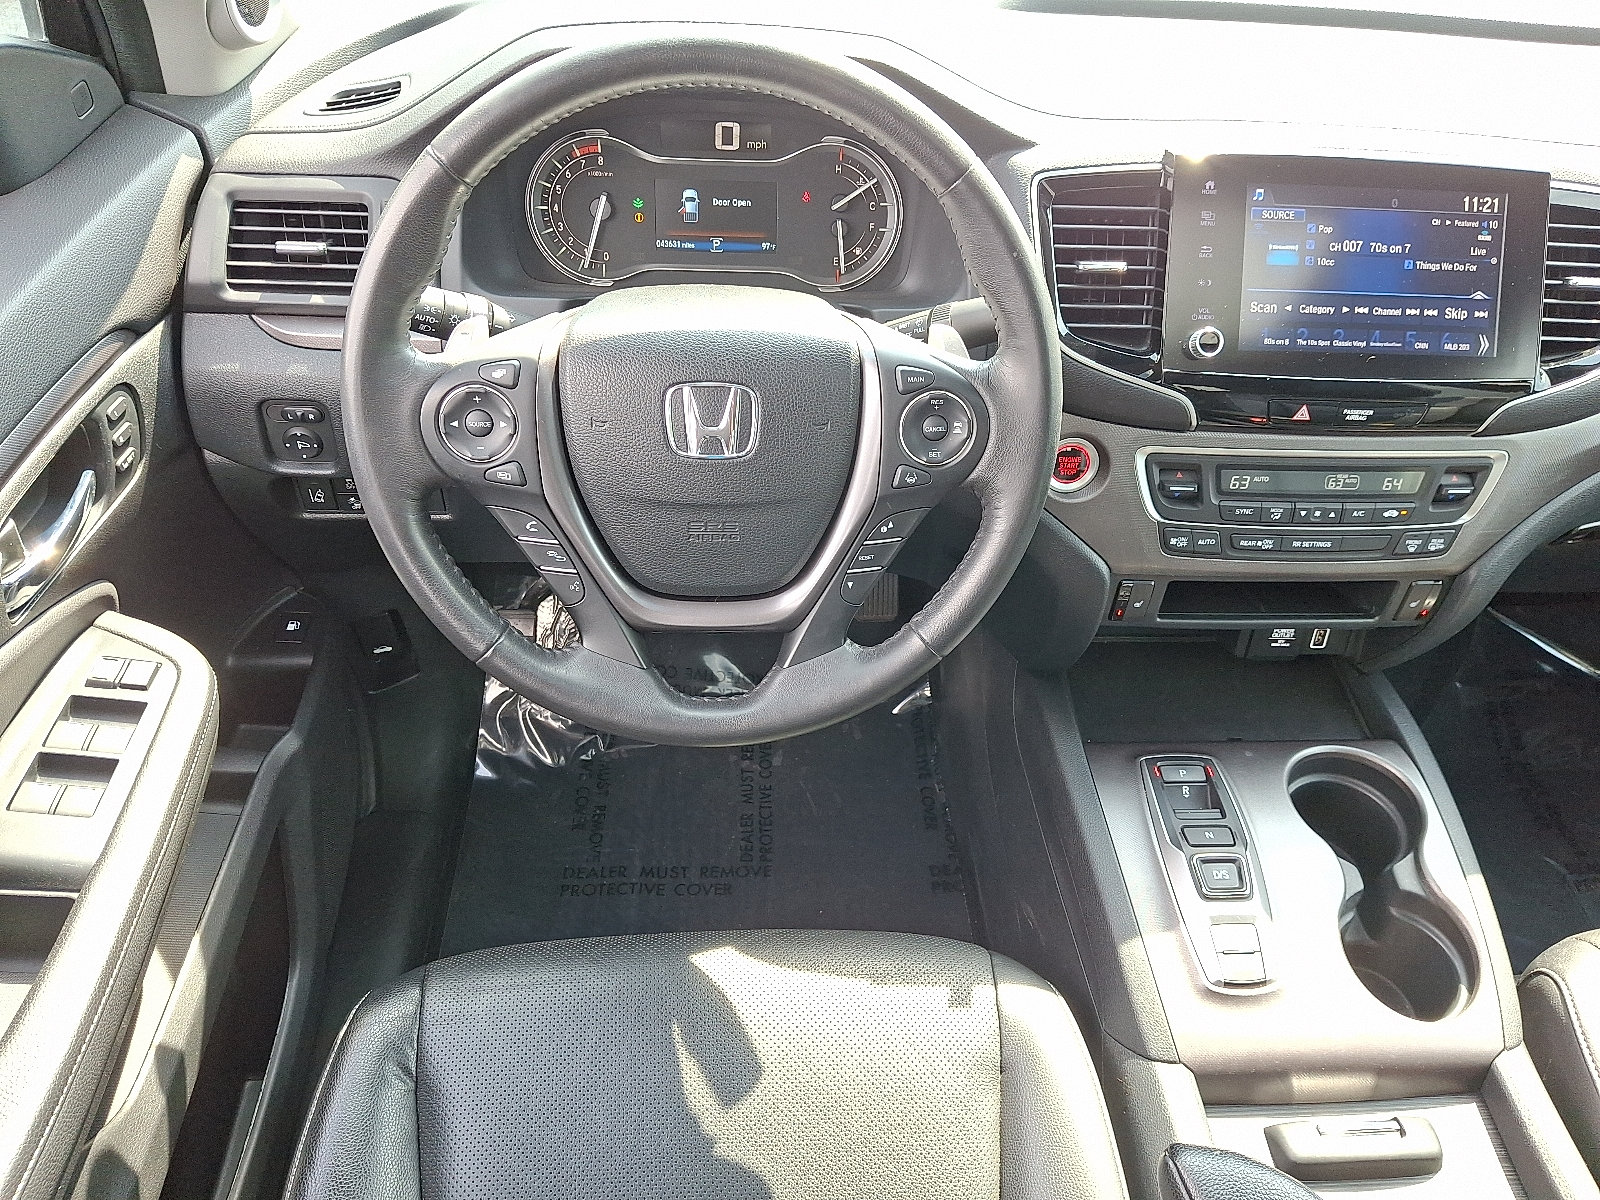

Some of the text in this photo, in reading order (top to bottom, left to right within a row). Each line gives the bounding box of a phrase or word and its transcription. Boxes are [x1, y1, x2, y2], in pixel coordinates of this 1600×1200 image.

[715, 121, 767, 151] 0 mph
[580, 160, 586, 169] 7
[598, 157, 604, 166] 8
[835, 164, 842, 174] H
[565, 170, 572, 178] 6
[556, 185, 562, 194] 5
[712, 198, 752, 208] Door Open
[869, 202, 876, 211] C
[1463, 196, 1499, 213] 11:21
[553, 204, 558, 212] 4
[1262, 210, 1295, 220] SOURCE
[558, 222, 564, 231] 3
[869, 223, 875, 232] F
[1454, 220, 1479, 228] Featured
[1488, 220, 1498, 229] 10
[1318, 225, 1334, 234] Pop
[568, 237, 574, 246] 2
[656, 240, 680, 248] 043631
[1329, 240, 1412, 254] CH 007 70s on 7
[1470, 246, 1487, 256] Live
[604, 252, 610, 261] 0
[833, 257, 838, 266] E
[1316, 258, 1336, 266] 10cc
[1416, 261, 1478, 272] Things We Do For
[1250, 302, 1278, 314] Scan
[1299, 304, 1336, 314] Category
[1372, 307, 1402, 316] Channel
[1444, 308, 1468, 320] Skip
[415, 314, 436, 324] AUTO
[1352, 340, 1367, 348] Vinyl
[1230, 476, 1251, 490] 63
[1328, 478, 1344, 488] 63
[1382, 478, 1404, 490] 64
[688, 533, 740, 542] AIRBAG
[1178, 769, 1188, 778] P
[740, 768, 755, 804] MUST
[1182, 786, 1190, 795] R
[758, 743, 774, 864] PROTECTIVE COVE
[740, 813, 755, 863] DEALER
[562, 864, 773, 880] DEALER MUST REMOVE
[1212, 870, 1230, 880] D/S
[560, 882, 732, 898] PROTECTIVE COVER
